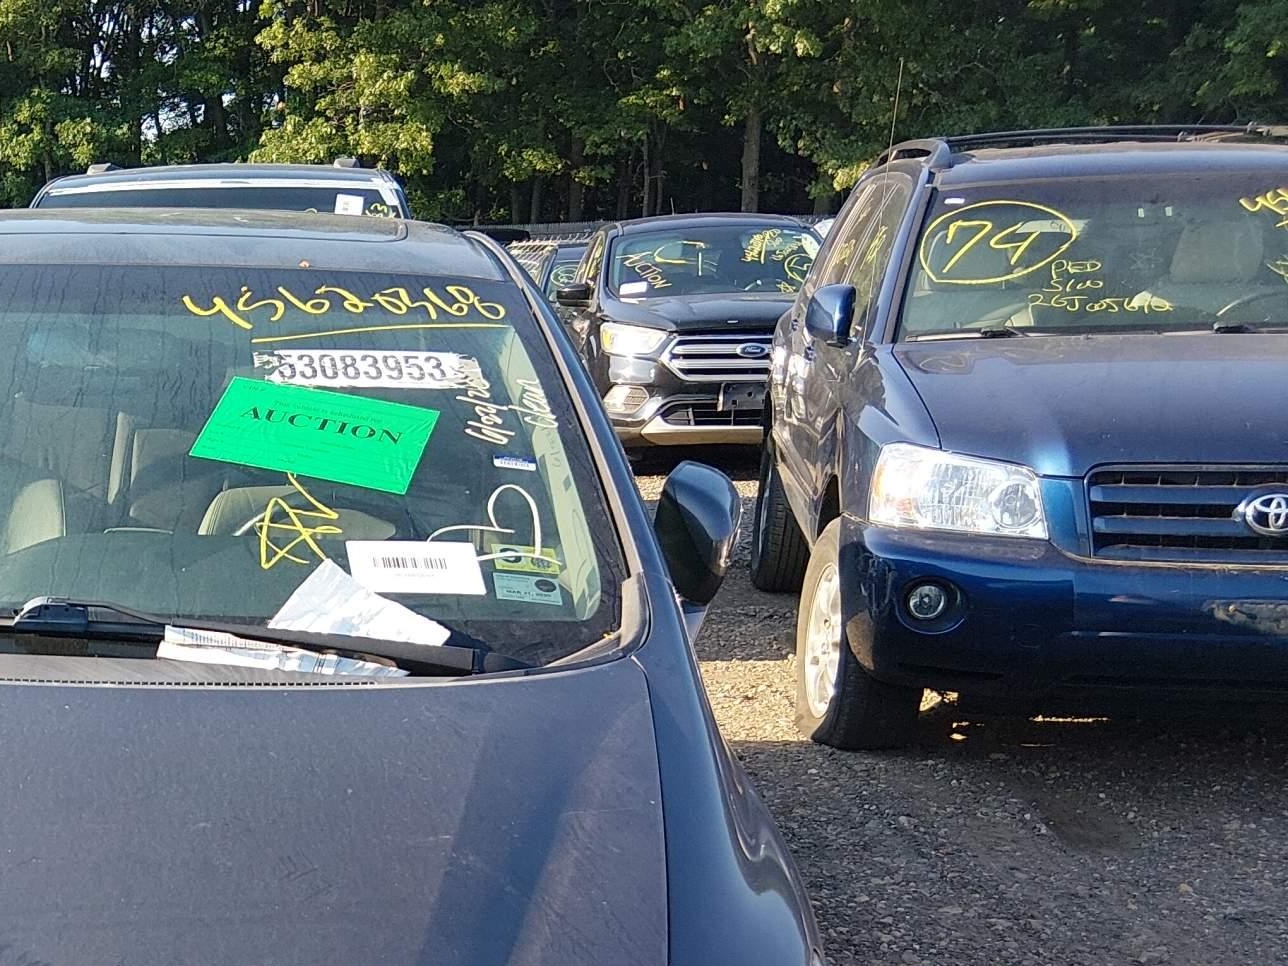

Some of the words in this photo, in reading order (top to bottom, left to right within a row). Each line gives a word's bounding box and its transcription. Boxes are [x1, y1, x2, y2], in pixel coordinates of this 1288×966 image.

[1051, 259, 1102, 280] PED
[278, 353, 447, 382] 53083953
[241, 406, 403, 446] AUCTION
